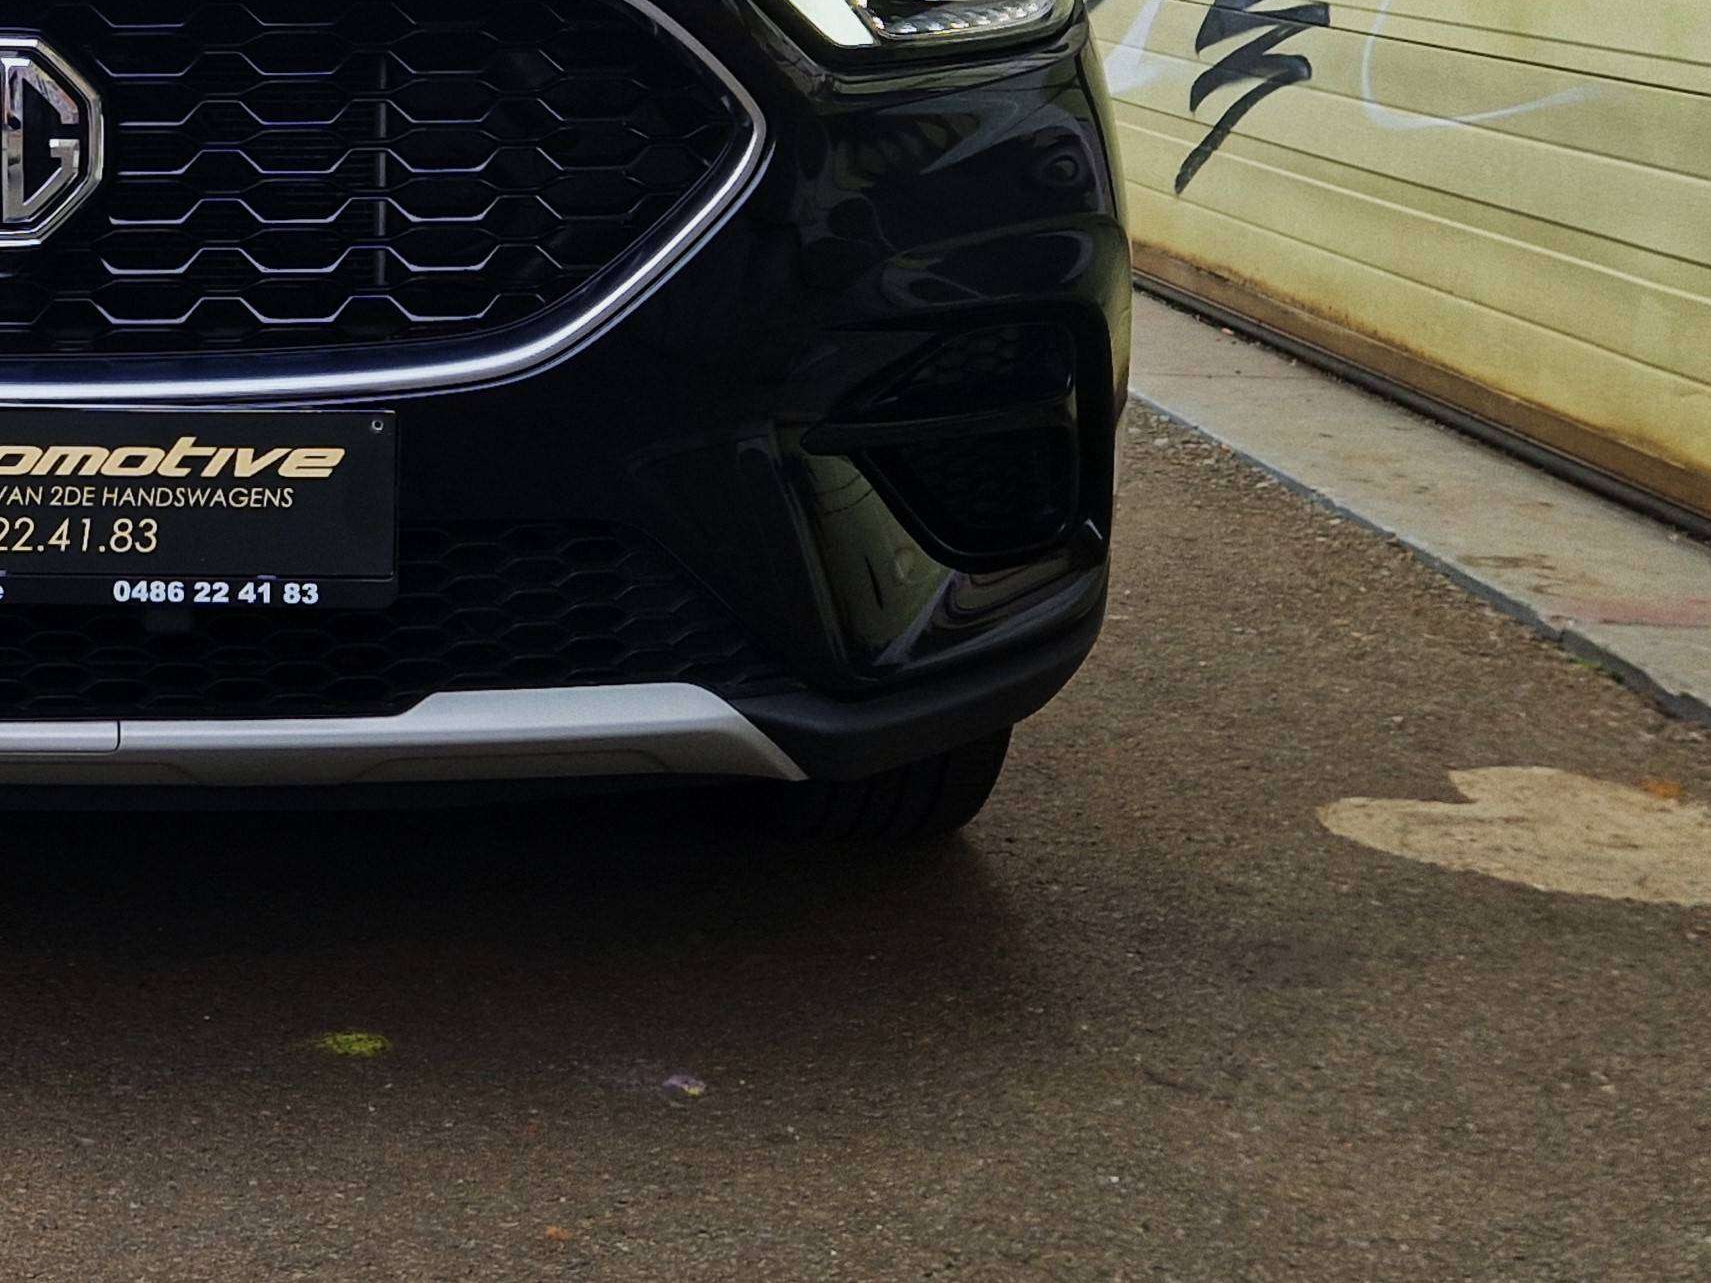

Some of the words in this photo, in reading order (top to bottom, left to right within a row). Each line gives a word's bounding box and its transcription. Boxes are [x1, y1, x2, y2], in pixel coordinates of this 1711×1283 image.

[50, 486, 96, 507] 2DE
[102, 486, 294, 509] HANDSWAGENS
[113, 580, 185, 603] 0486
[193, 581, 230, 604] 22
[237, 582, 272, 605] 41
[282, 582, 319, 605] 83
